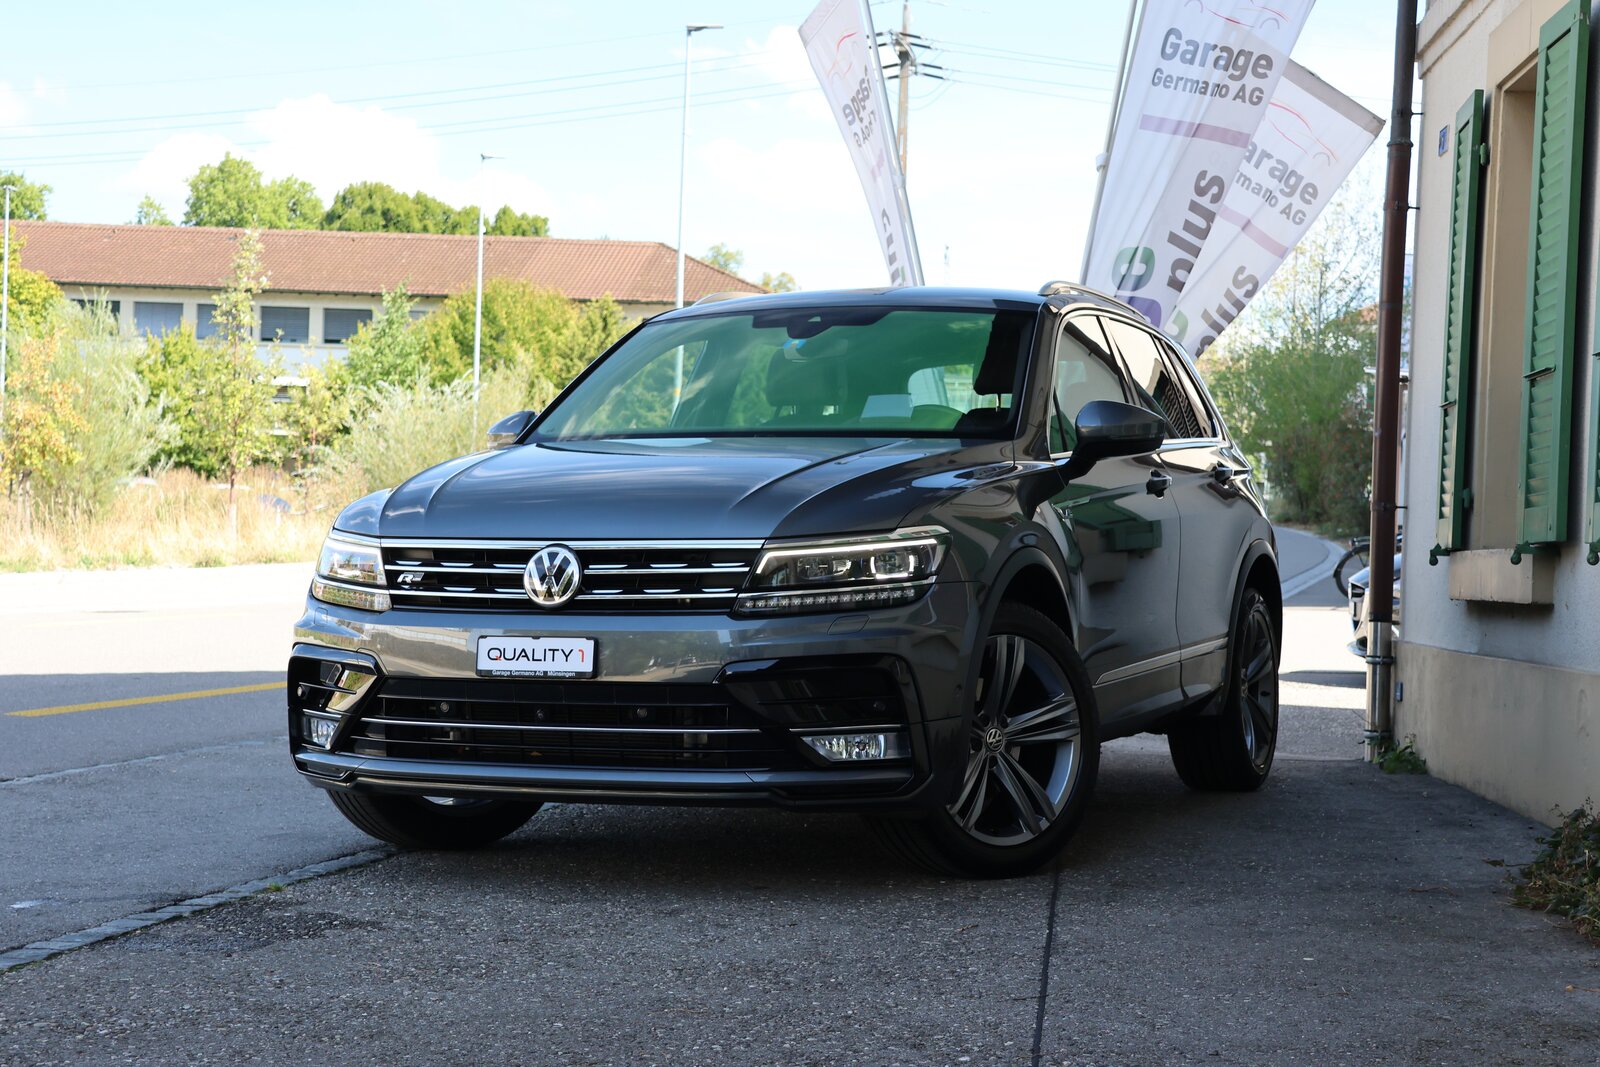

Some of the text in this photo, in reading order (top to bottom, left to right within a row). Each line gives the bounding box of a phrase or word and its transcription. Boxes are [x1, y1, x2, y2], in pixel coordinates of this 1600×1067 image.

[1160, 27, 1274, 82] Garage
[1151, 67, 1265, 106] Germano AG
[1235, 170, 1307, 226] mano AG
[1243, 141, 1319, 206] arage
[487, 647, 585, 663] QUALITY 1
